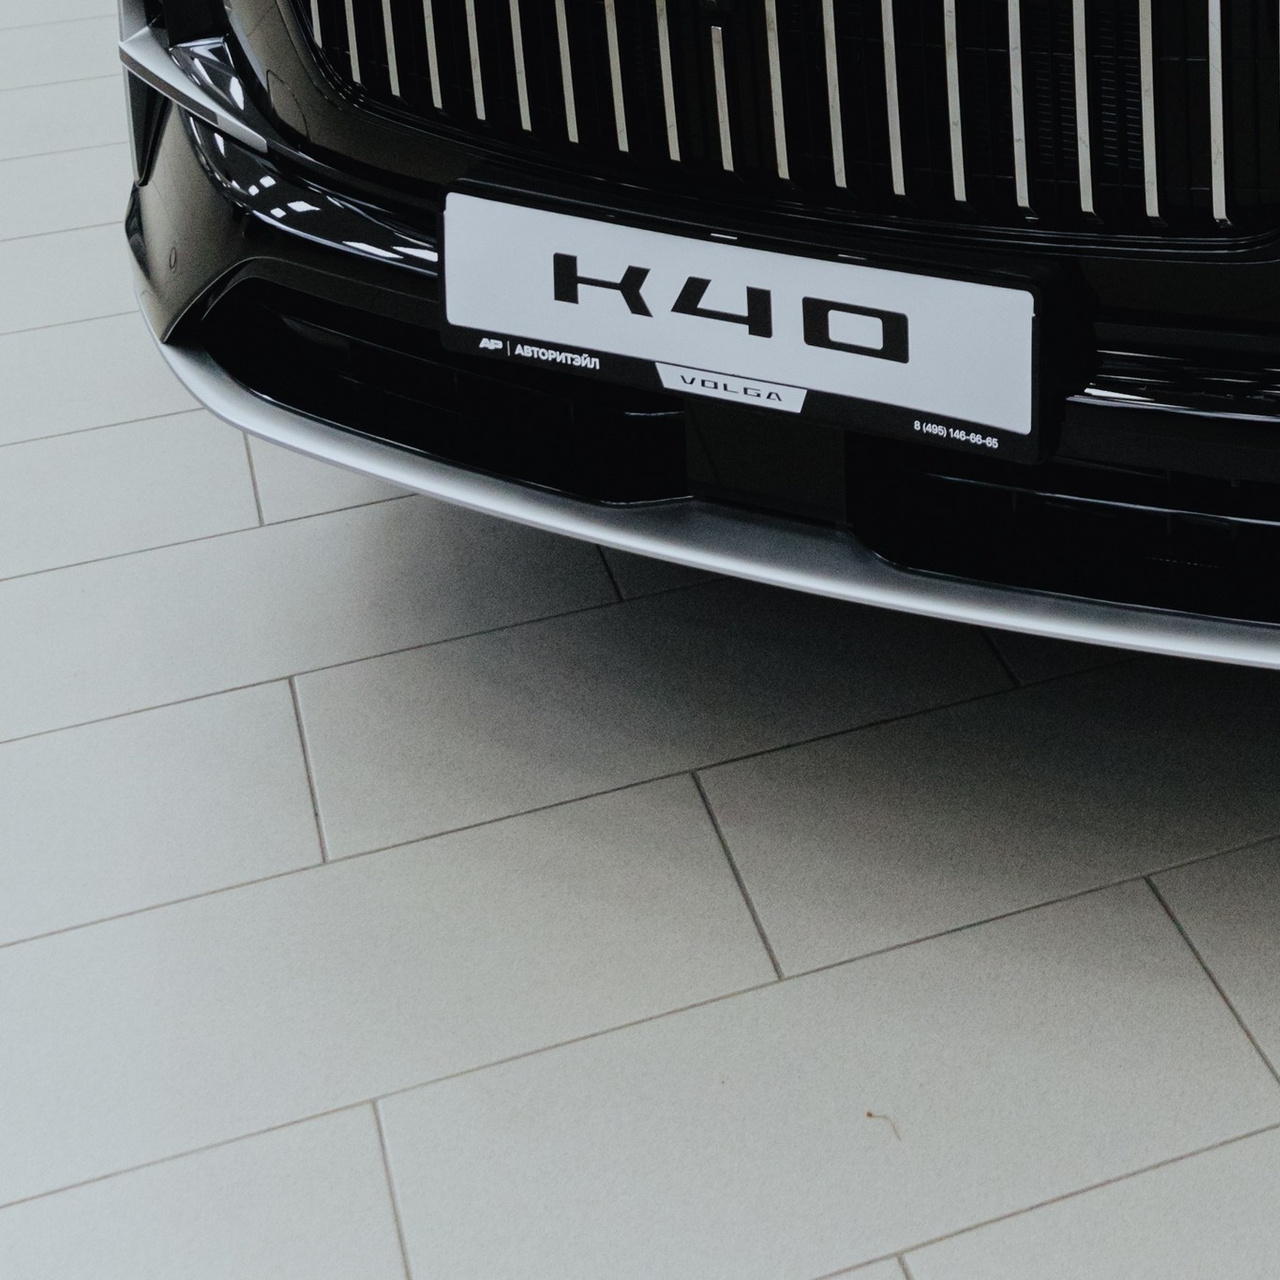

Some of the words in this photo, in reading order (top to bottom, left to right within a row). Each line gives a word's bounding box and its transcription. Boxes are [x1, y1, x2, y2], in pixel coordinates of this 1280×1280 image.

[553, 252, 909, 364] K40
[515, 344, 600, 370] АВТОРИТЭЙЛ
[680, 375, 782, 401] VOLGA
[914, 420, 920, 430] 8
[923, 422, 947, 437] (495)
[949, 428, 998, 448] 146-66-65
